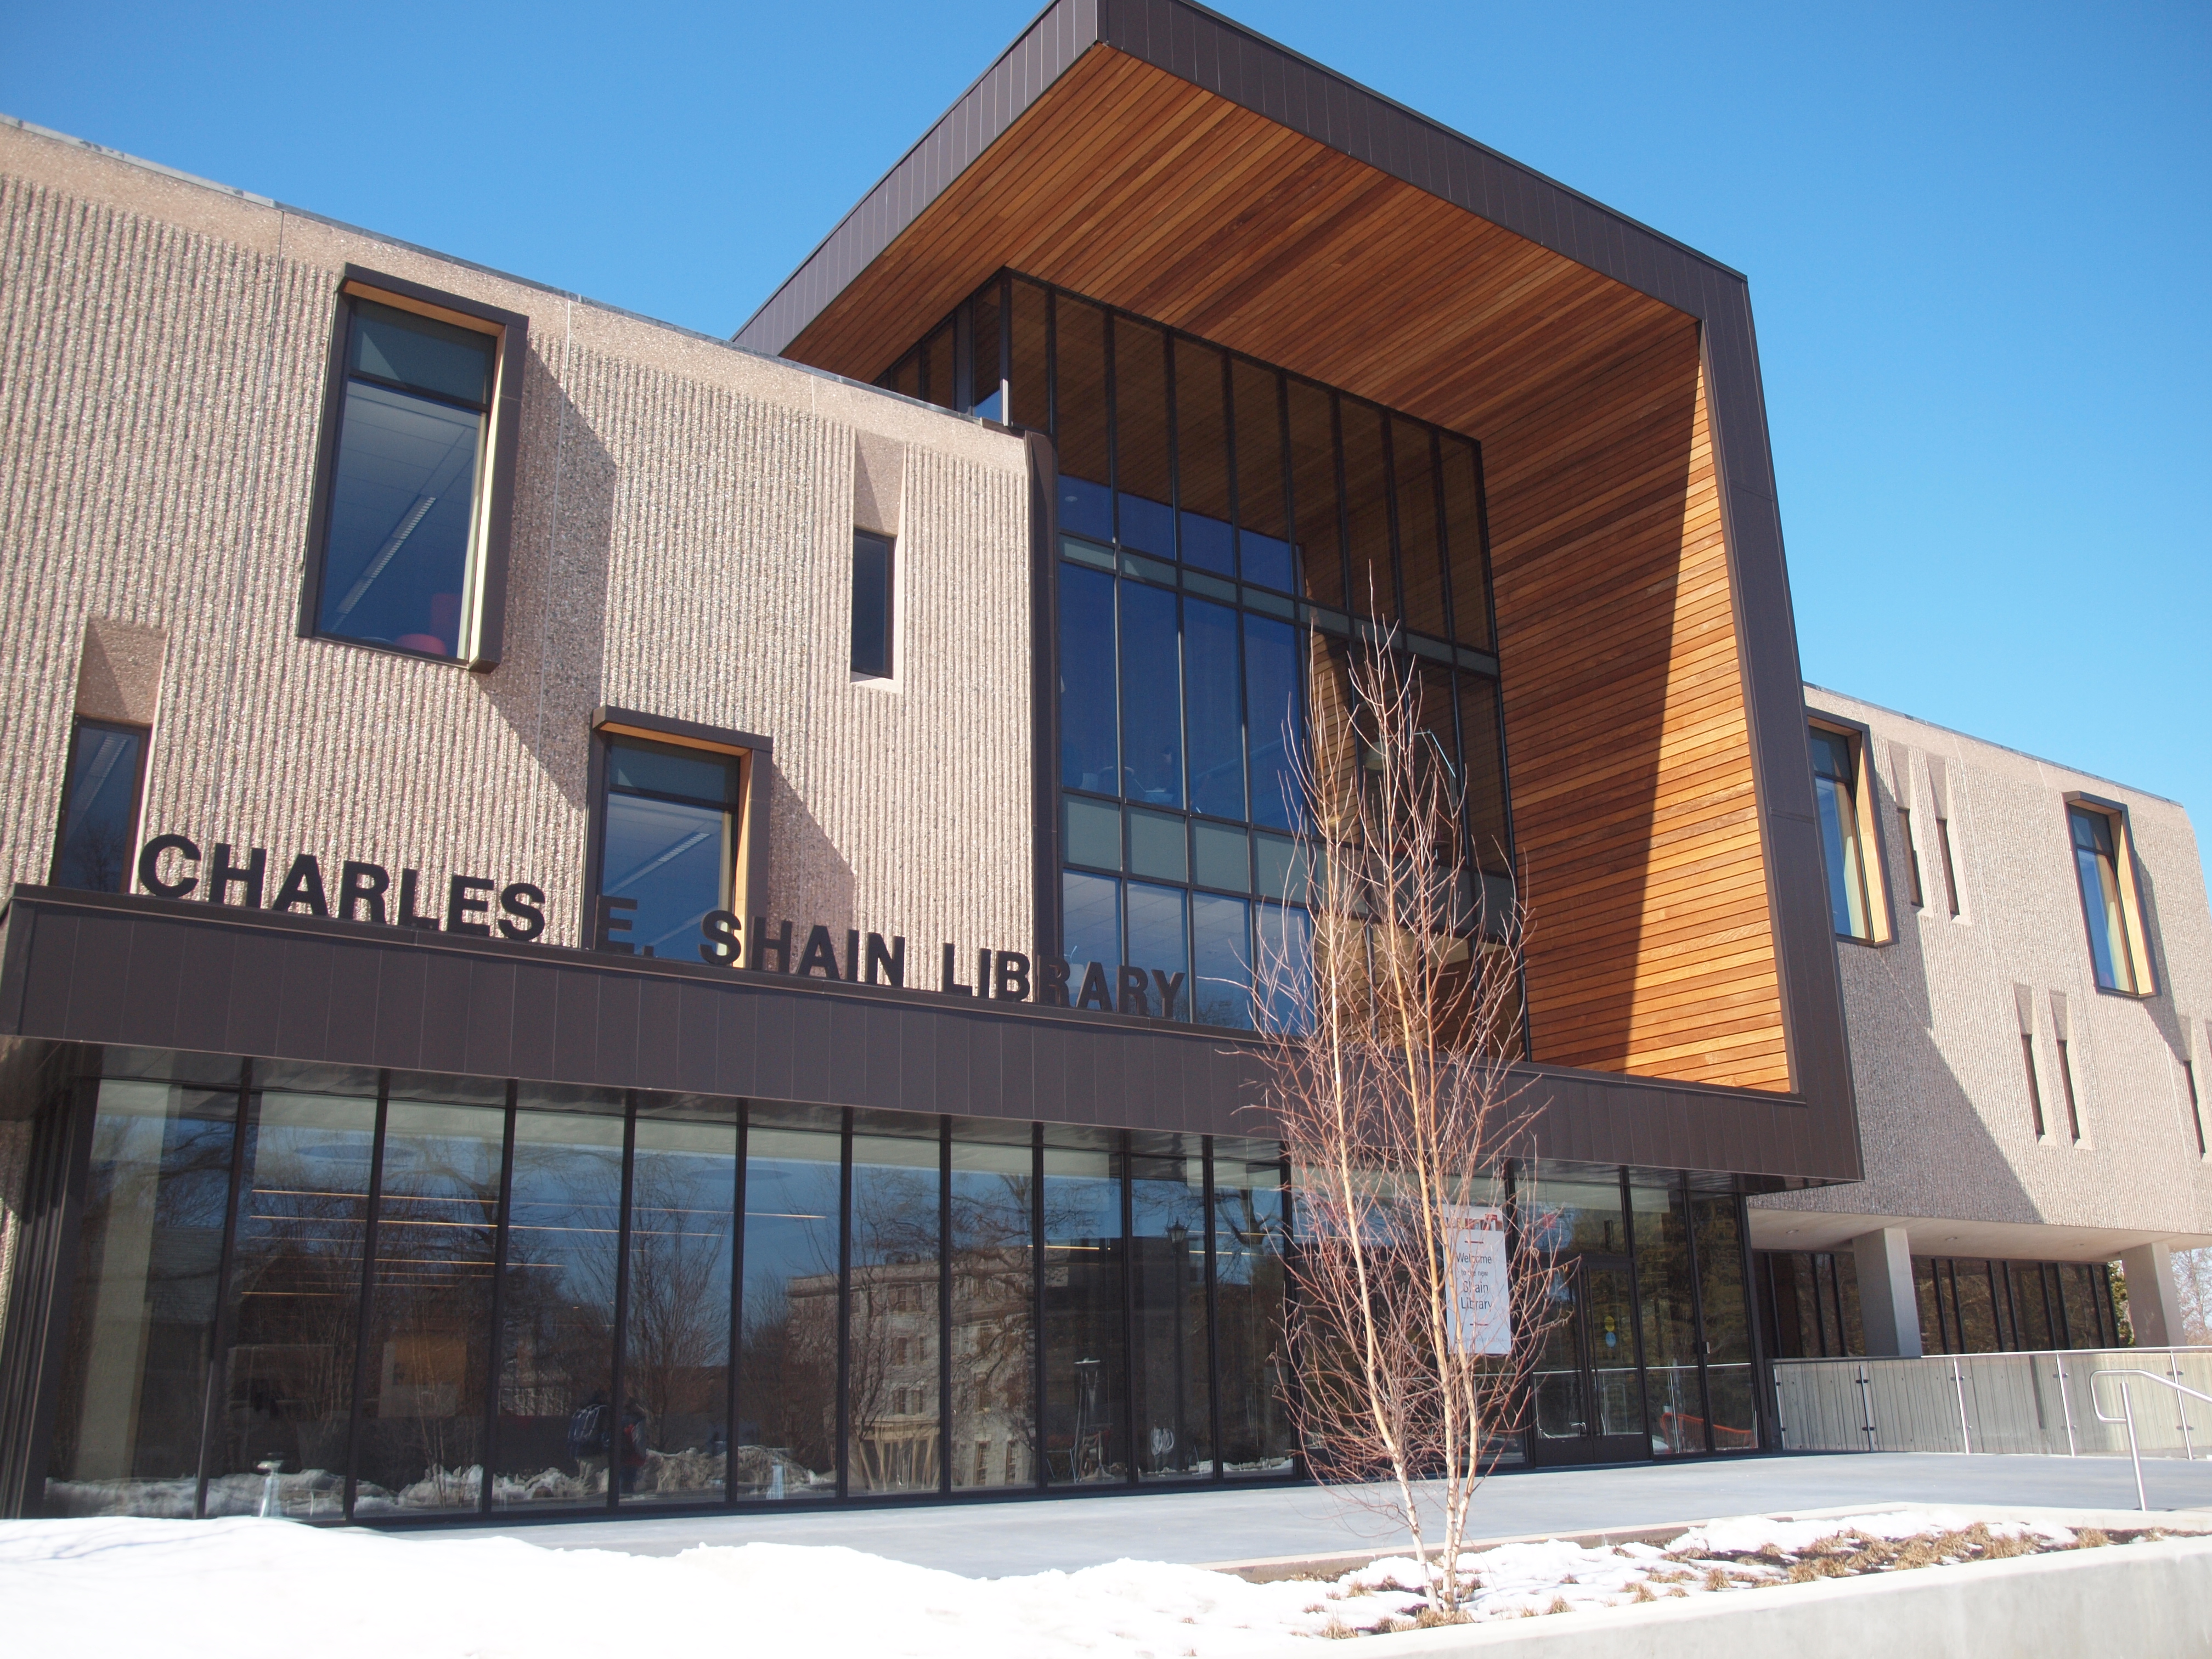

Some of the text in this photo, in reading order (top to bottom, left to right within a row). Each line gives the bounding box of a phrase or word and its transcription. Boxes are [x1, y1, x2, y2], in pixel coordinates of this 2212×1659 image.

[138, 833, 1186, 1019] CHARLES E. SHAIN LIBRARY
